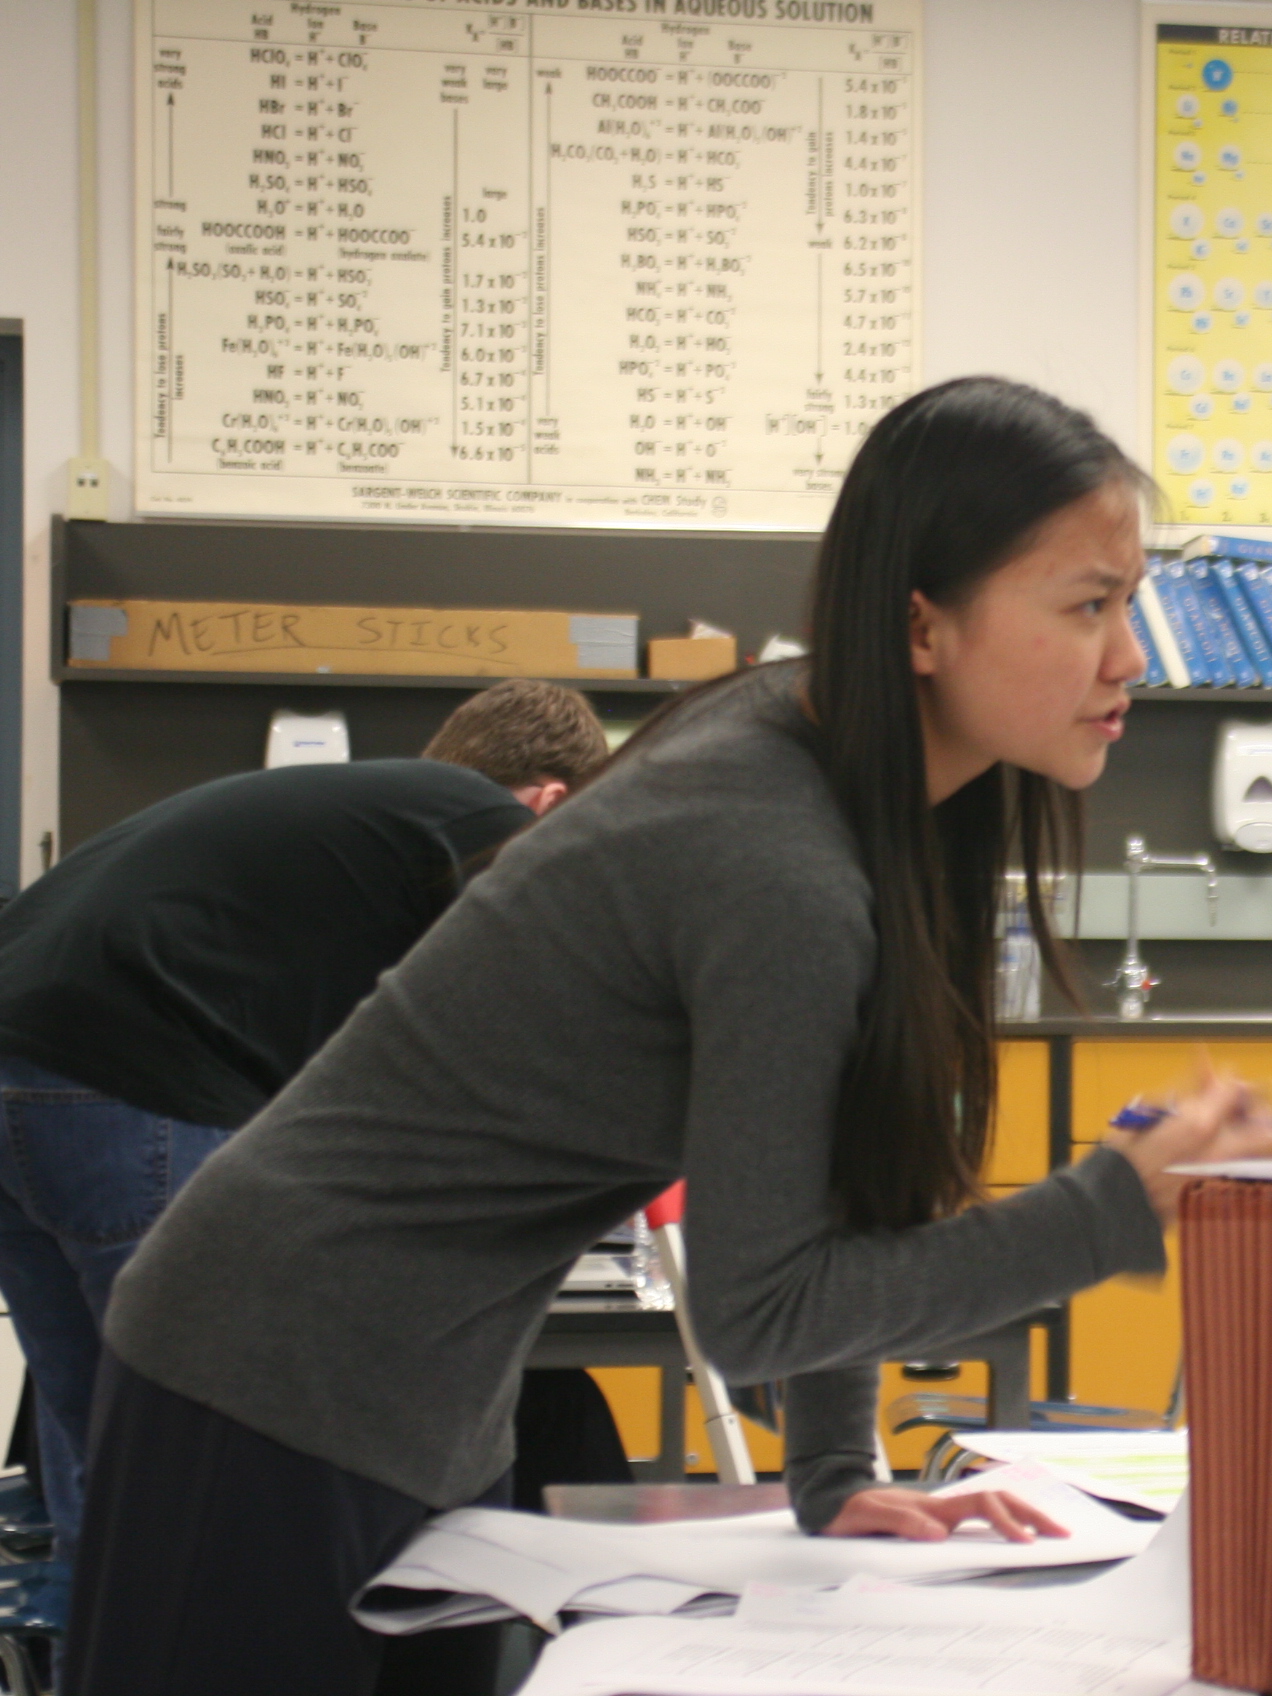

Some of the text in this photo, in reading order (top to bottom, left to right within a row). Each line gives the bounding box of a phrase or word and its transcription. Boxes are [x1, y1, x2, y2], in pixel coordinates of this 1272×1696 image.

[290, 3, 342, 17] Hydrogen
[674, 0, 768, 19] AQUEOUS
[774, 2, 875, 23] SOLUTION
[251, 14, 274, 26] Acid
[307, 18, 325, 29] Ion
[353, 20, 378, 31] Base
[661, 23, 711, 36] Hydrogen
[622, 34, 644, 47] Acid
[845, 78, 867, 93] 5.4
[846, 105, 867, 119] 1.8
[844, 156, 867, 171] 4.4
[805, 170, 818, 216] Tendency
[846, 183, 868, 197] 1.0
[441, 194, 453, 241] increases
[463, 208, 487, 223] 1.0
[843, 210, 867, 224] 6.3
[532, 207, 546, 252] increases
[461, 232, 485, 248] 5.4
[843, 236, 867, 250] 6.2
[441, 246, 455, 285] protons
[463, 273, 484, 289] 1.7
[536, 254, 548, 293] protons
[843, 289, 866, 303] 5.7
[462, 299, 485, 313] 1.3
[156, 313, 168, 344] protons
[843, 315, 866, 329] 4.7
[461, 323, 483, 338] 7.1
[440, 327, 454, 373] Tendency
[460, 348, 485, 362] 6.0
[533, 331, 547, 375] Tendency
[843, 342, 867, 356] 2.4
[174, 354, 185, 400] increases
[460, 372, 483, 386] 6.7
[843, 368, 866, 383] 4.4
[460, 396, 483, 411] 5.1
[154, 391, 166, 438] Tendency
[462, 421, 484, 436] 1.5
[459, 446, 484, 460] 6.6
[351, 485, 441, 501] SARGENT-WELCH
[446, 488, 503, 502] SCIENTIFIC
[505, 489, 563, 504] COMPANY
[641, 493, 673, 507] CHEM
[675, 494, 707, 510] Study
[149, 610, 511, 658] METER STICKS
[1162, 597, 1195, 662] GIANCOLI
[1184, 597, 1218, 663] GIANCOLI
[1235, 597, 1270, 662] GIANCOLI
